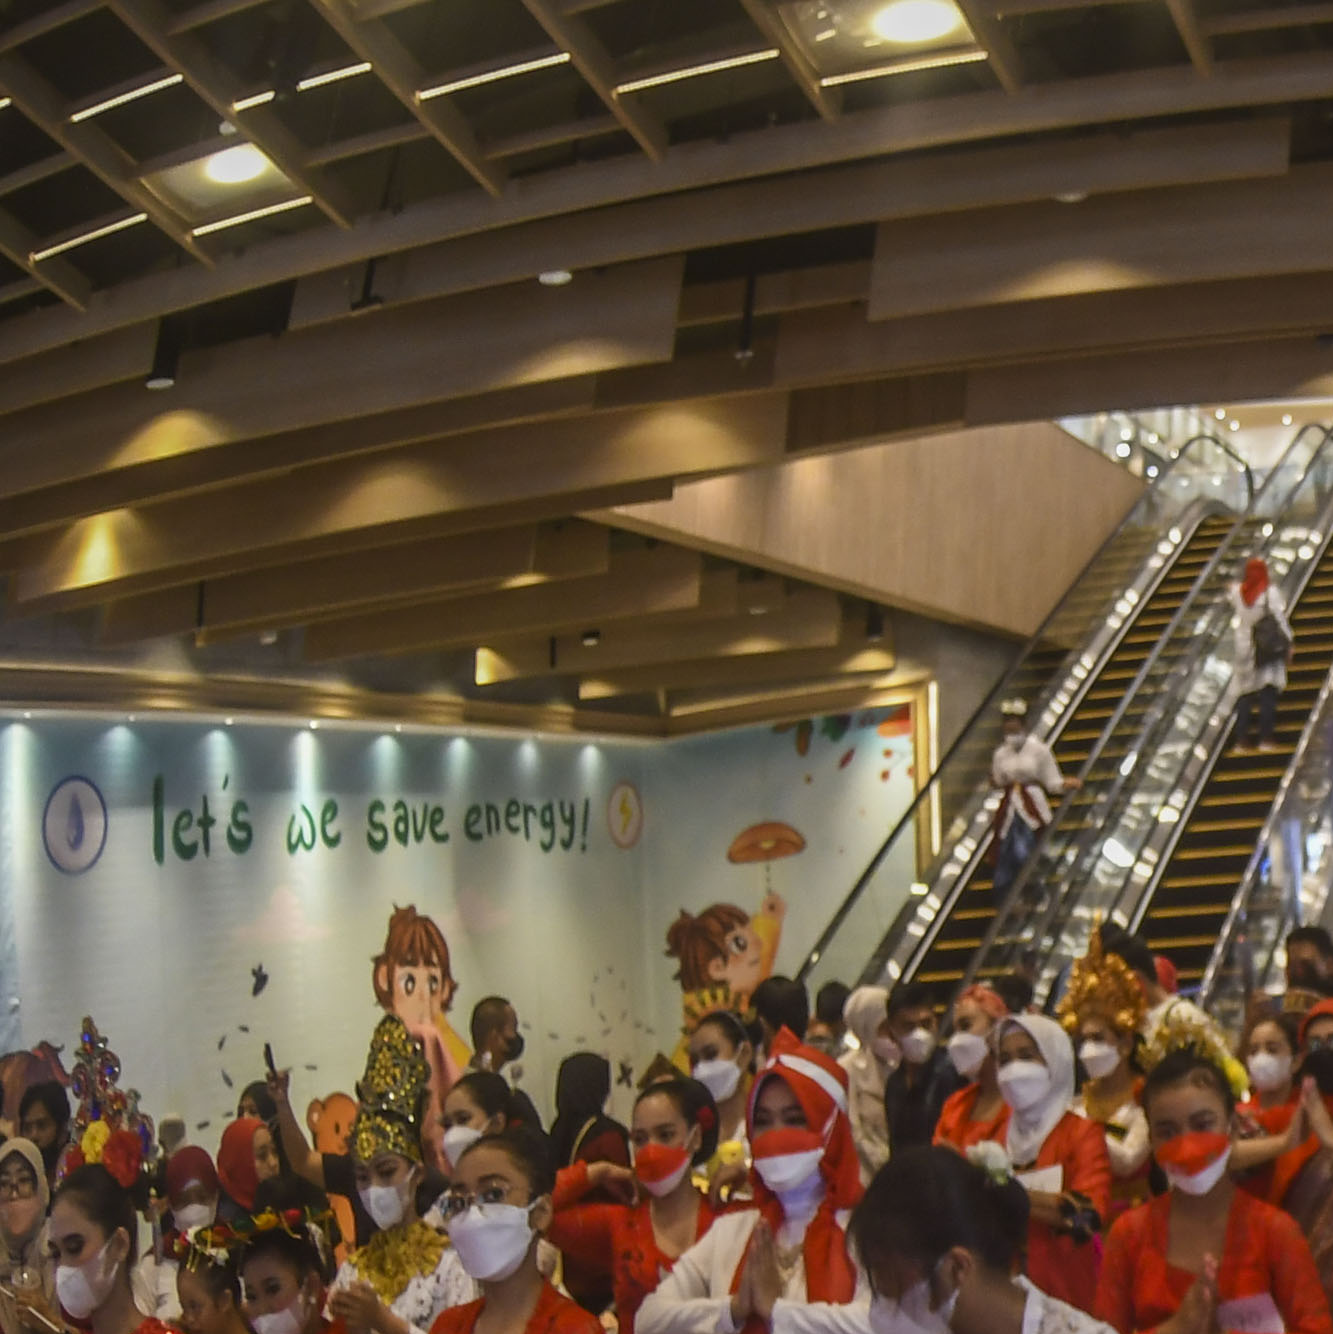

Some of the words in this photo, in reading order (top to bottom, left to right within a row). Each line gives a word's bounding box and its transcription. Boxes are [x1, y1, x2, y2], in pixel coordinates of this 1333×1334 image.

[153, 774, 253, 866] let's
[286, 797, 342, 856] we
[366, 799, 450, 853] save
[464, 797, 591, 853] energy!
